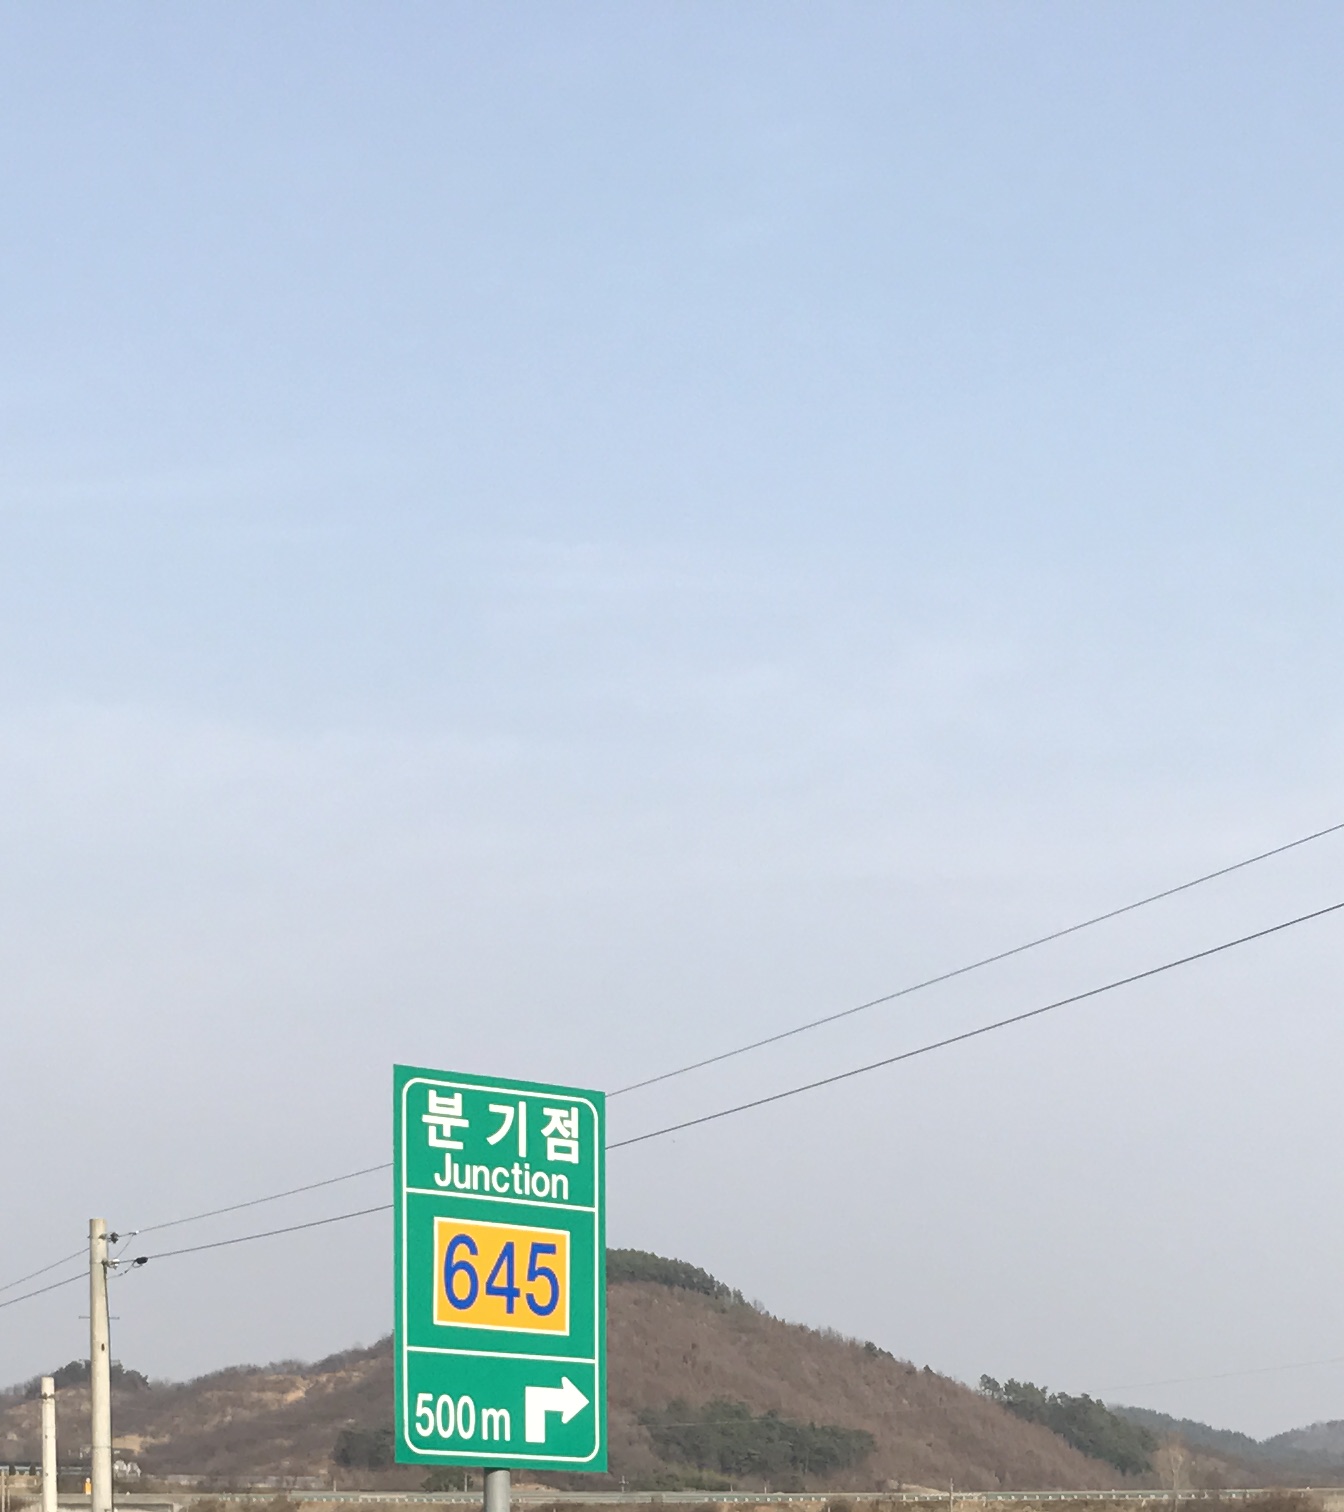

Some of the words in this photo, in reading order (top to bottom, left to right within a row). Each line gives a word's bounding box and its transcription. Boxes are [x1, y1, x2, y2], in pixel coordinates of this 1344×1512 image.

[434, 1152, 569, 1200] Junction
[443, 1233, 560, 1317] 645
[415, 1392, 511, 1442] 500m
